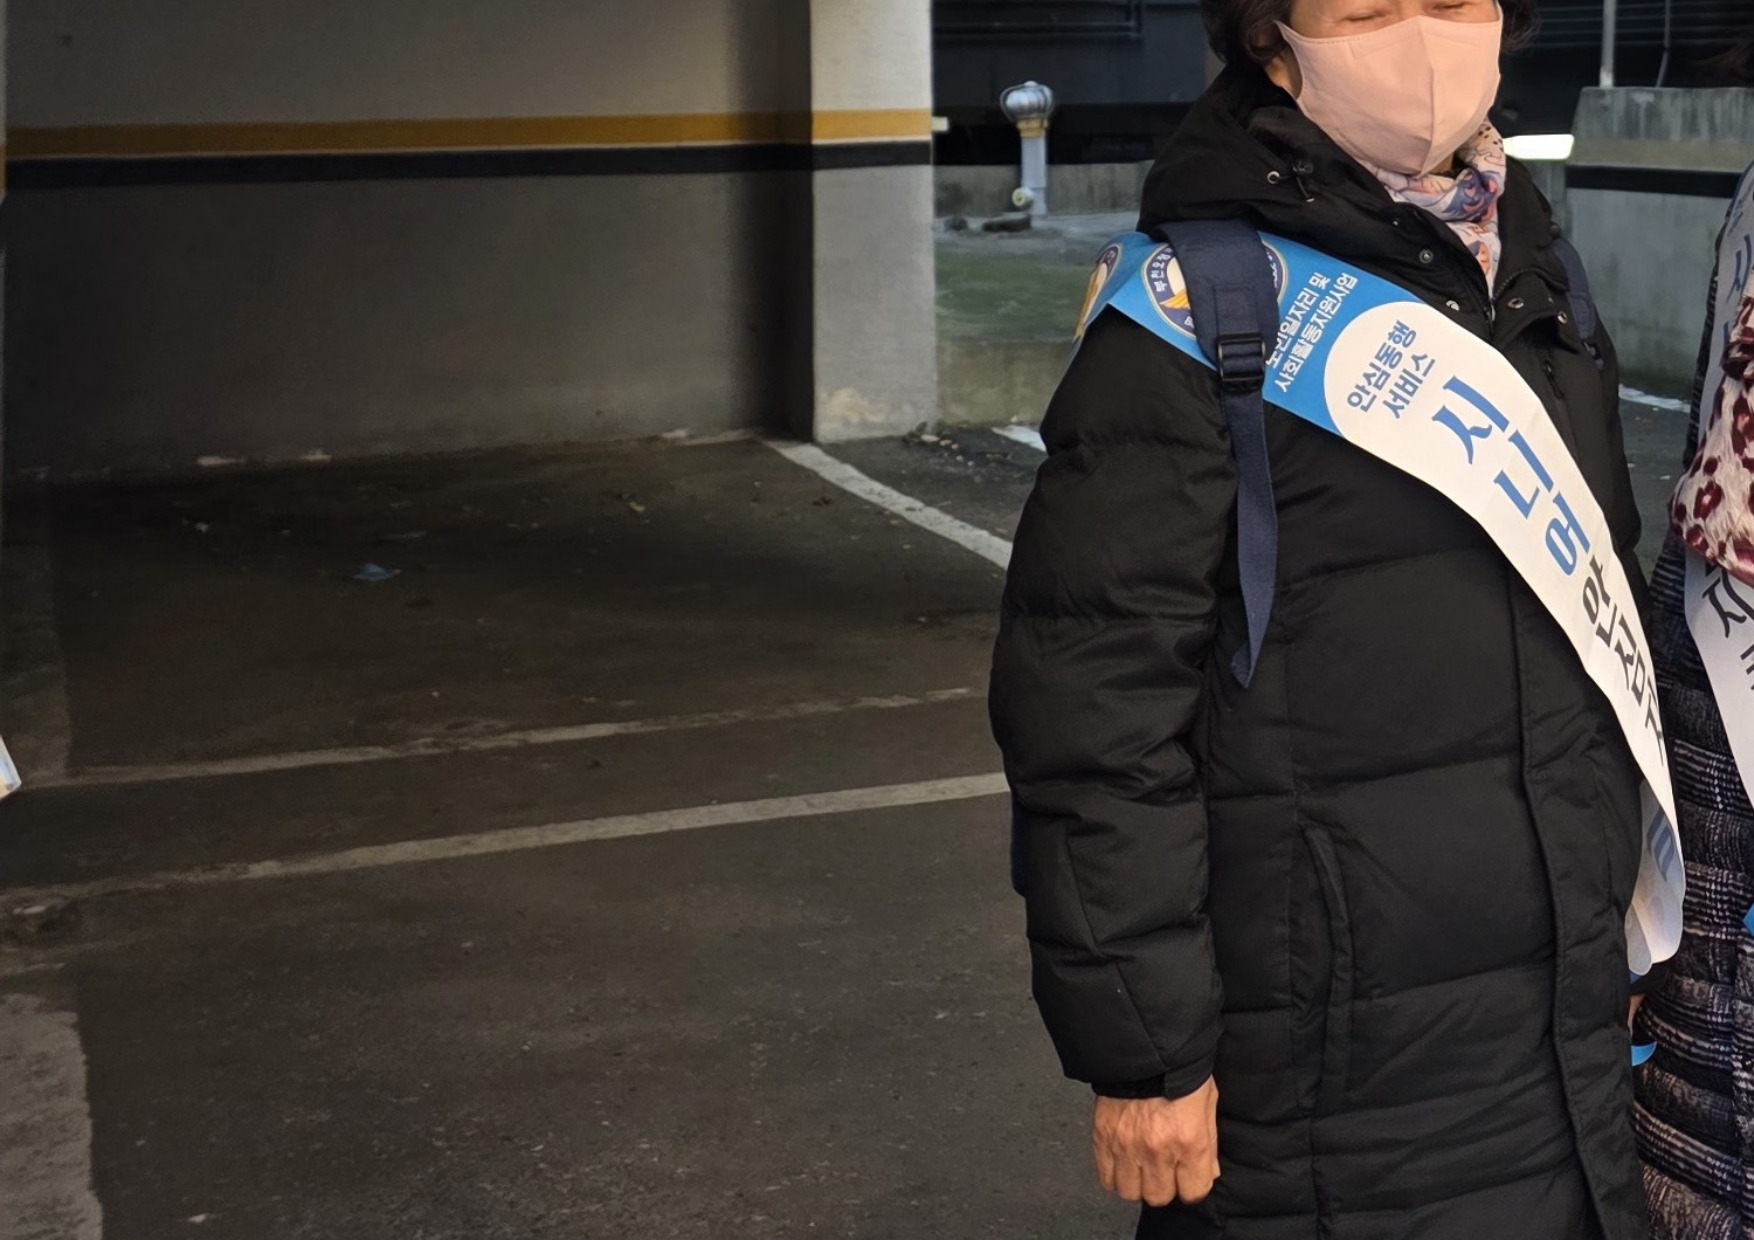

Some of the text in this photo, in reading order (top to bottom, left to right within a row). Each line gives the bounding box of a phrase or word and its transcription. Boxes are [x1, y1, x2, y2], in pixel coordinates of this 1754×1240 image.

[1265, 287, 1320, 369] 노인일자리
[1308, 272, 1332, 290] 및
[1346, 319, 1417, 413] 안심동행
[1382, 353, 1436, 419] 서비스
[1431, 375, 1591, 577] 시니어
